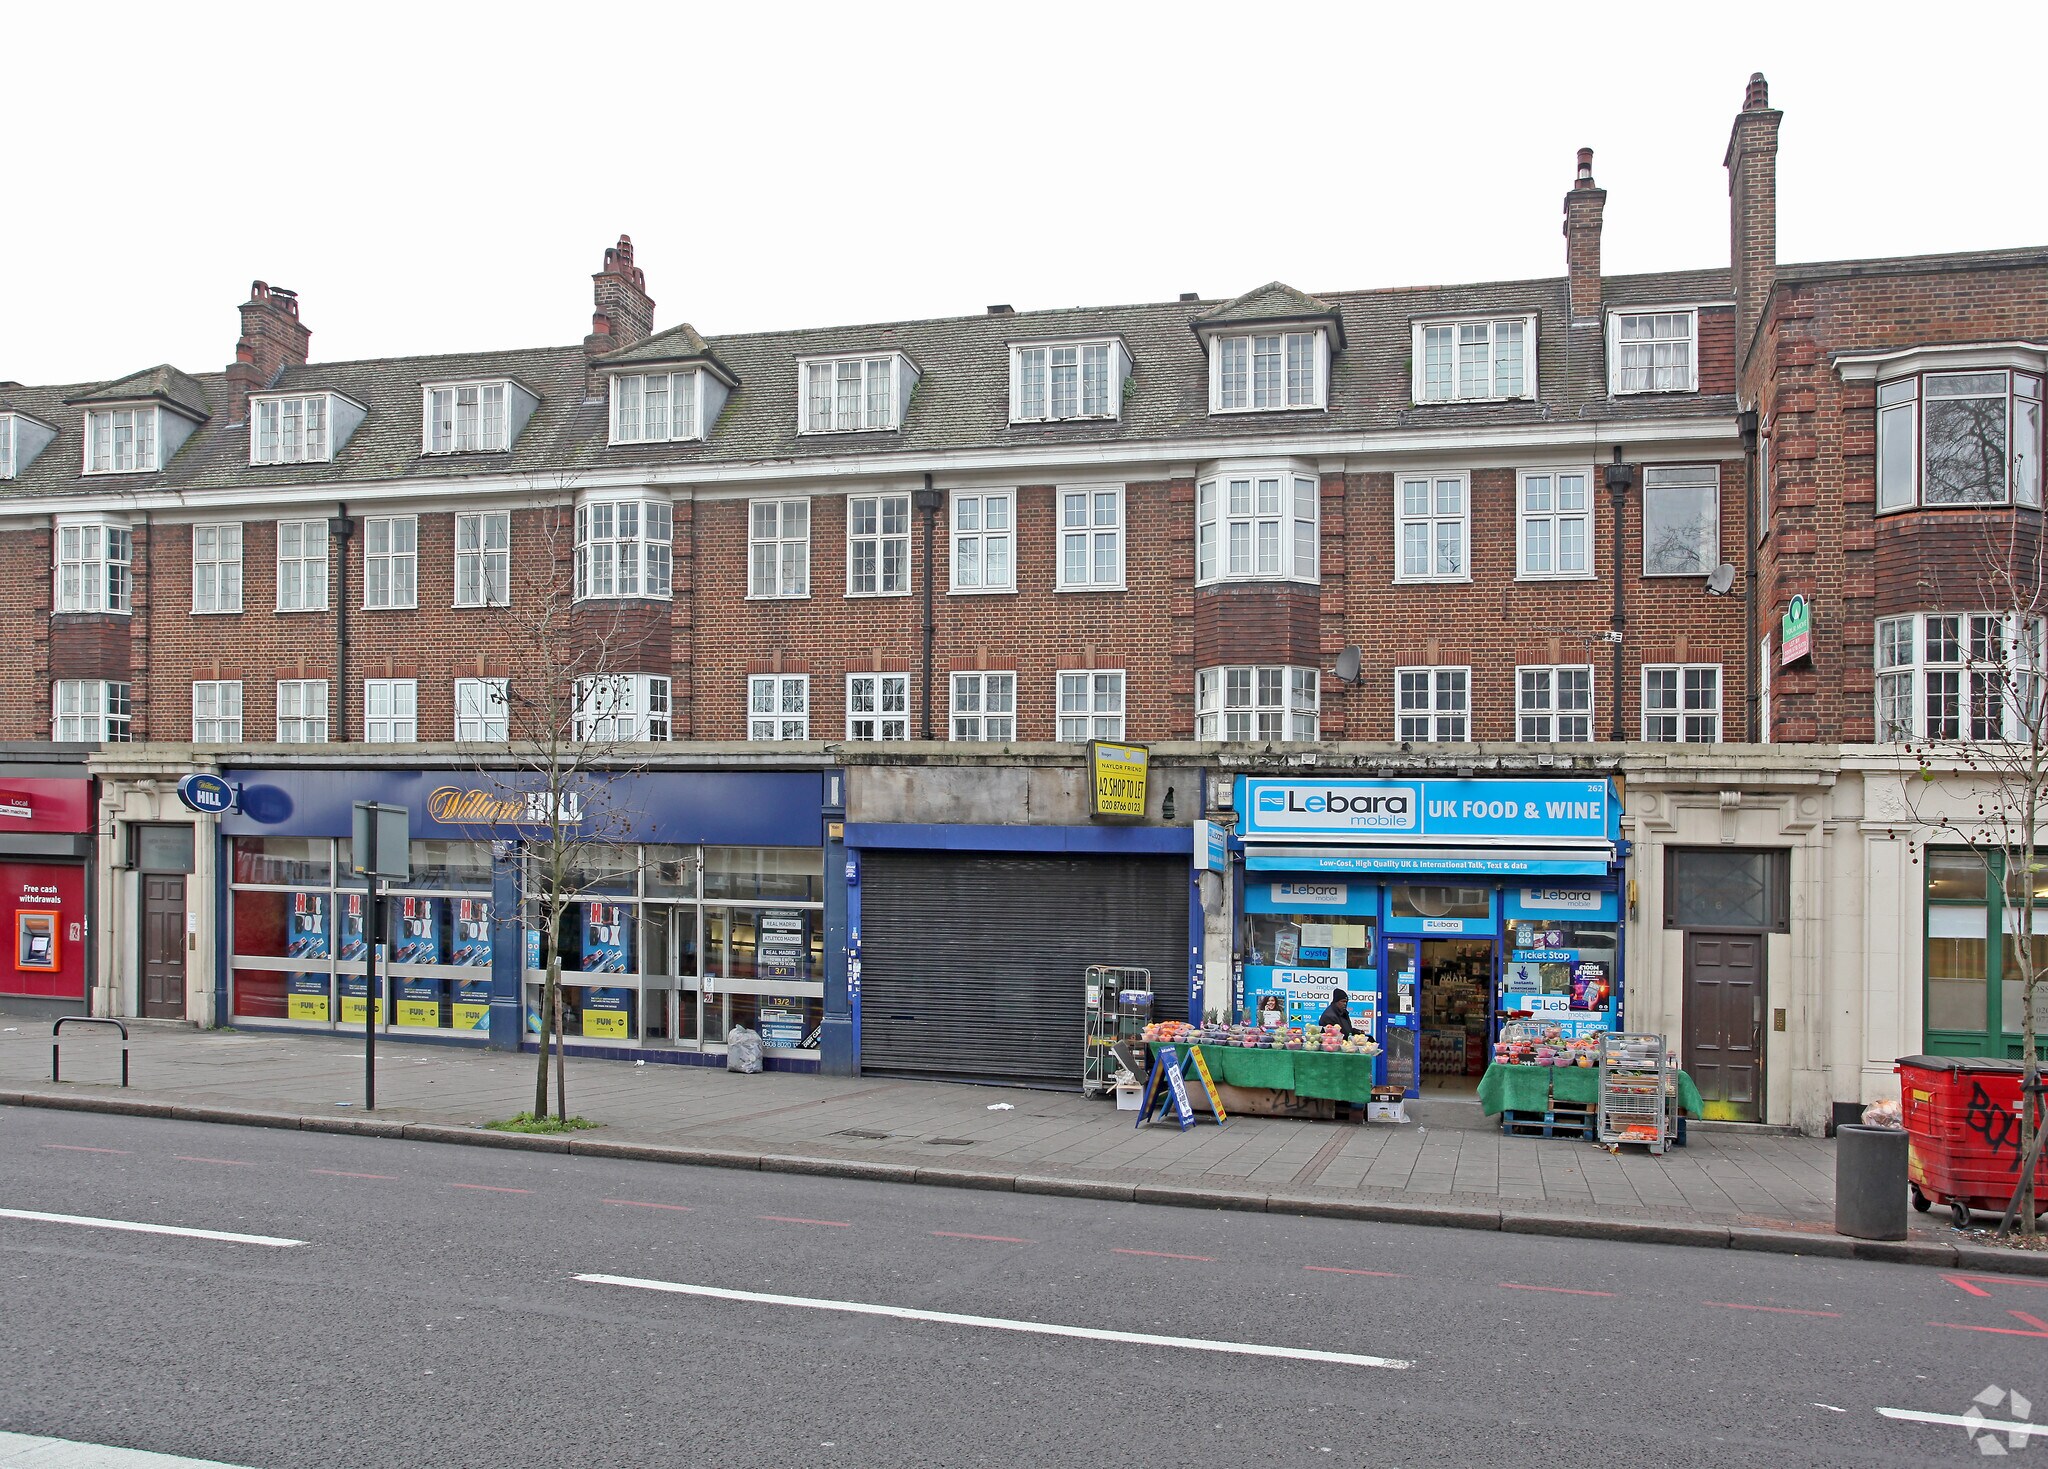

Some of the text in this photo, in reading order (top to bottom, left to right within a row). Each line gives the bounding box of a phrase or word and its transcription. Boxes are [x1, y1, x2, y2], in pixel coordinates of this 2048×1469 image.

[1124, 765, 1143, 773] FRIEND
[1099, 777, 1144, 799] A2 SHOP TO LET
[197, 790, 221, 806] HILL
[1288, 790, 1408, 814] Lebara
[427, 785, 527, 824] William
[1101, 799, 1141, 812] 020 8766 0123
[1428, 800, 1601, 820] UK FOOD & WINE
[1351, 815, 1408, 826] mobile
[1319, 859, 1355, 868] Low-Cost,
[1355, 860, 1373, 869] High
[1373, 860, 1400, 870] Quality
[1420, 861, 1467, 869] International
[1467, 861, 1486, 870] Talk,
[1487, 862, 1503, 870] Text
[1511, 862, 1528, 870] data
[23, 884, 58, 893] Free cash
[1292, 884, 1338, 895] Lebara
[19, 894, 62, 904] withdrawals
[1543, 890, 1591, 901] Lebara
[1304, 949, 1328, 958] oyste
[1519, 951, 1570, 961] Ticket Stop
[774, 967, 787, 975] 3/1
[1293, 973, 1339, 985] Lebara
[1261, 988, 1286, 997] Lebara
[1296, 991, 1330, 1000] Lebara
[300, 1001, 314, 1009] FUN
[773, 997, 790, 1006] 13/2
[1543, 1000, 1570, 1011] Leb
[409, 1007, 424, 1016] FUN
[465, 1011, 480, 1019] FUN
[596, 1017, 612, 1025] FUN
[1582, 1022, 1608, 1030] Lebara
